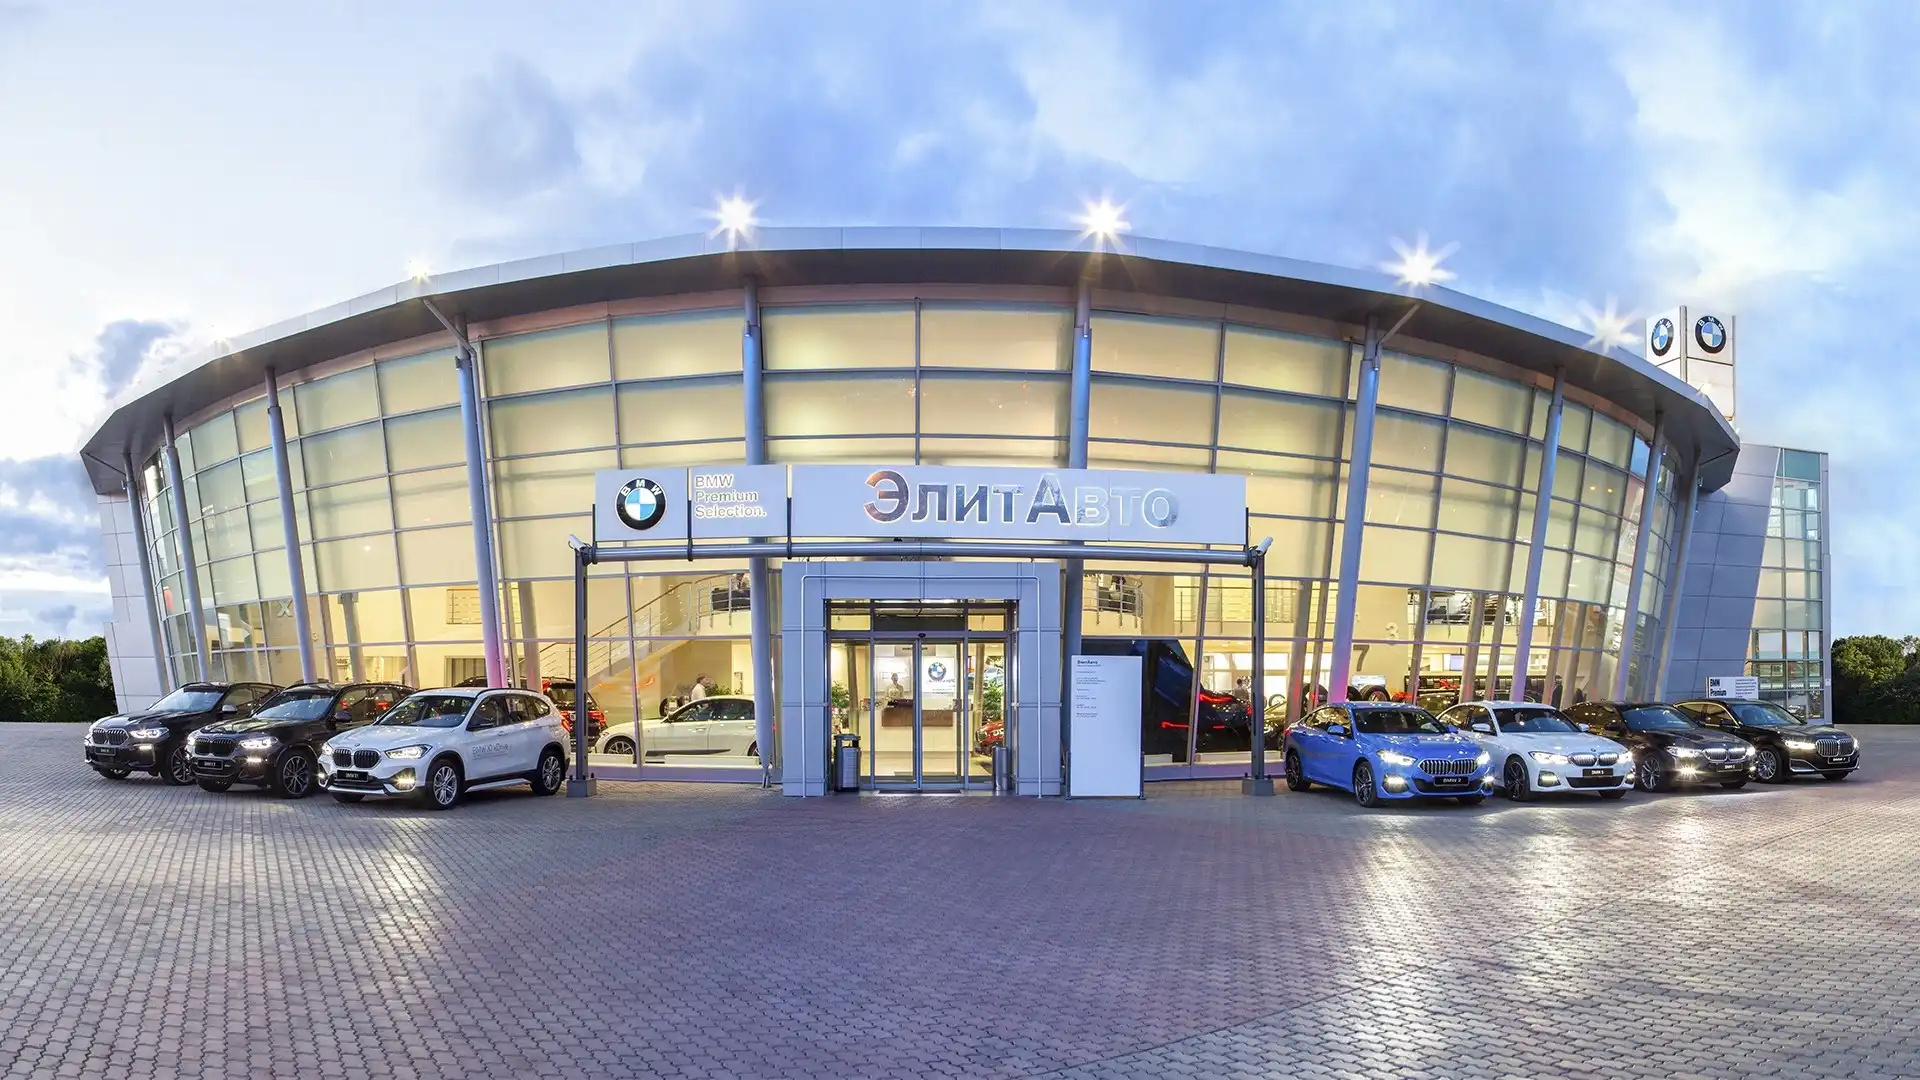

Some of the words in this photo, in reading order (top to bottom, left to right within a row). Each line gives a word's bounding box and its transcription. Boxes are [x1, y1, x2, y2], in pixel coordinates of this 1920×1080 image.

[620, 479, 662, 497] BMW
[694, 474, 734, 489] BMW
[694, 489, 760, 503] Premium
[863, 469, 1180, 528] ЭлитАвто
[694, 504, 768, 520] Selection.
[1353, 644, 1370, 672] 7
[1710, 678, 1720, 687] BMW
[1710, 688, 1727, 697] Premium
